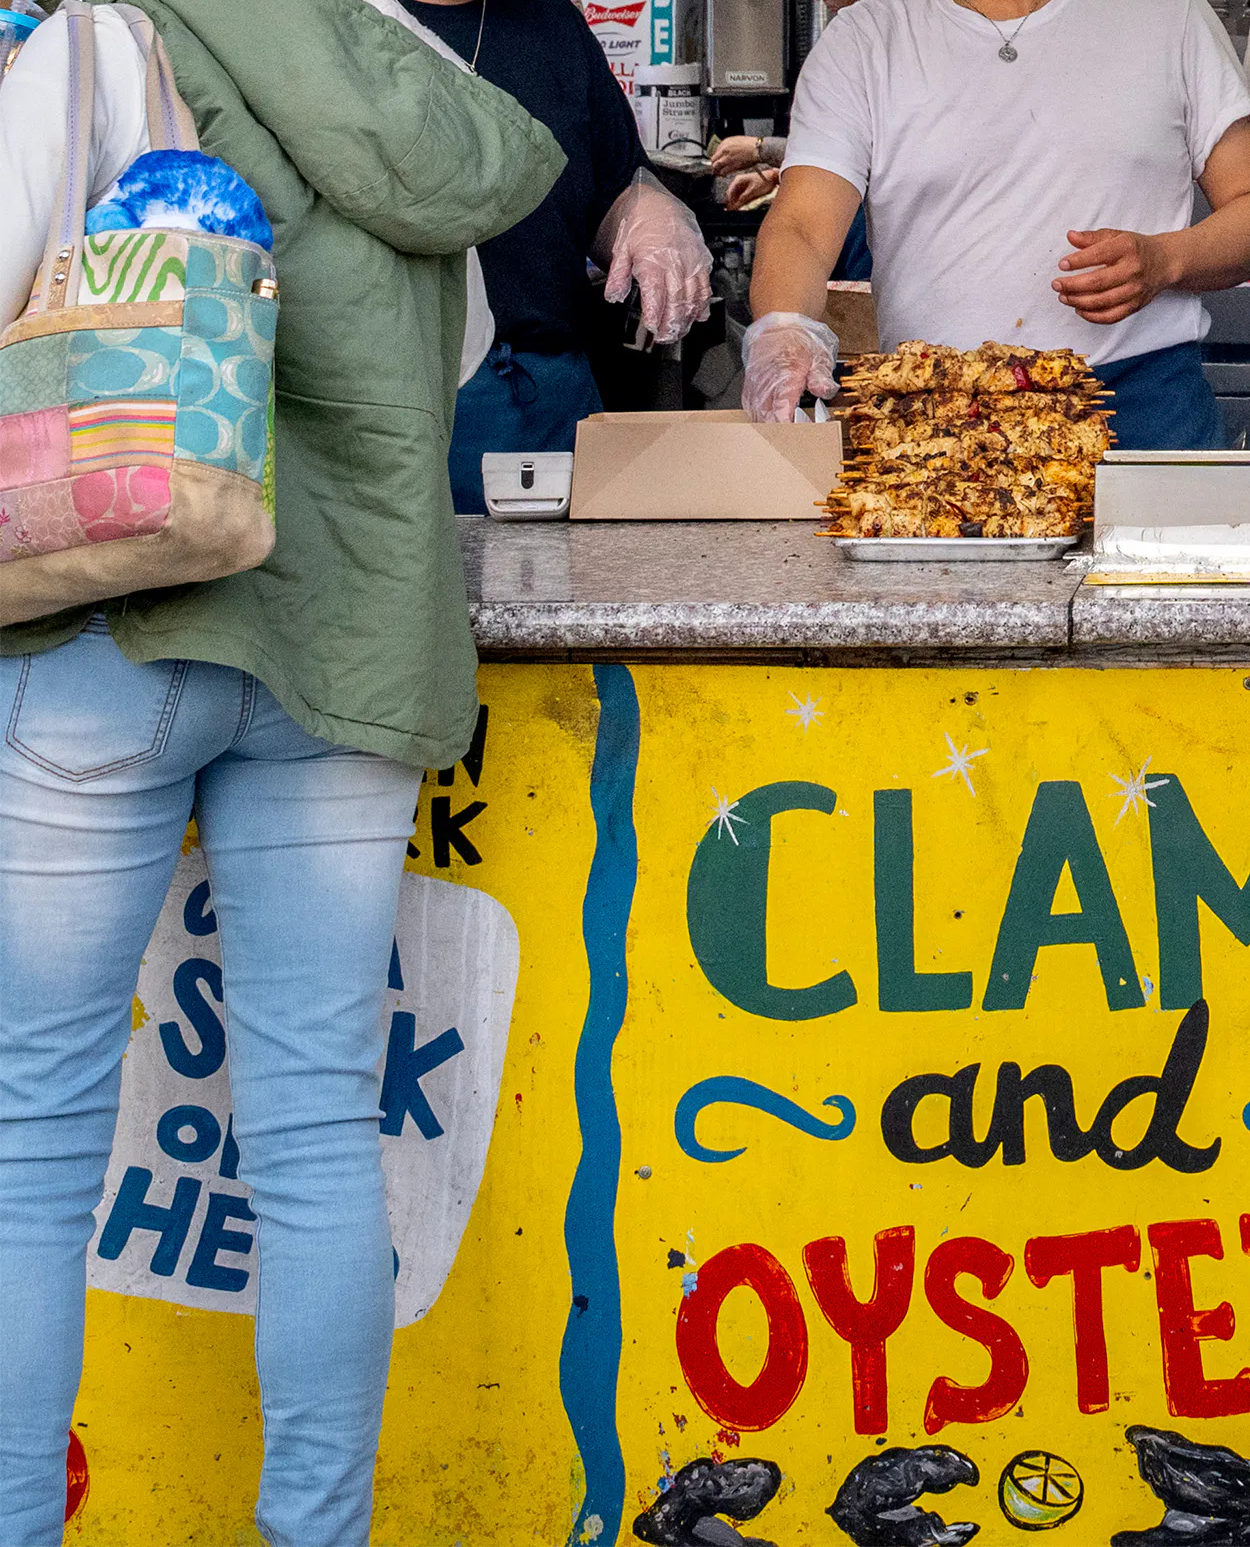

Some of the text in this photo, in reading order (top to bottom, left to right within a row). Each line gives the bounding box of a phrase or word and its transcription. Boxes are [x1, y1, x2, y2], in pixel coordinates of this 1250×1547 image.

[584, 7, 641, 22] Budweiser
[609, 40, 641, 49] LIGHT
[880, 999, 1223, 1174] and
